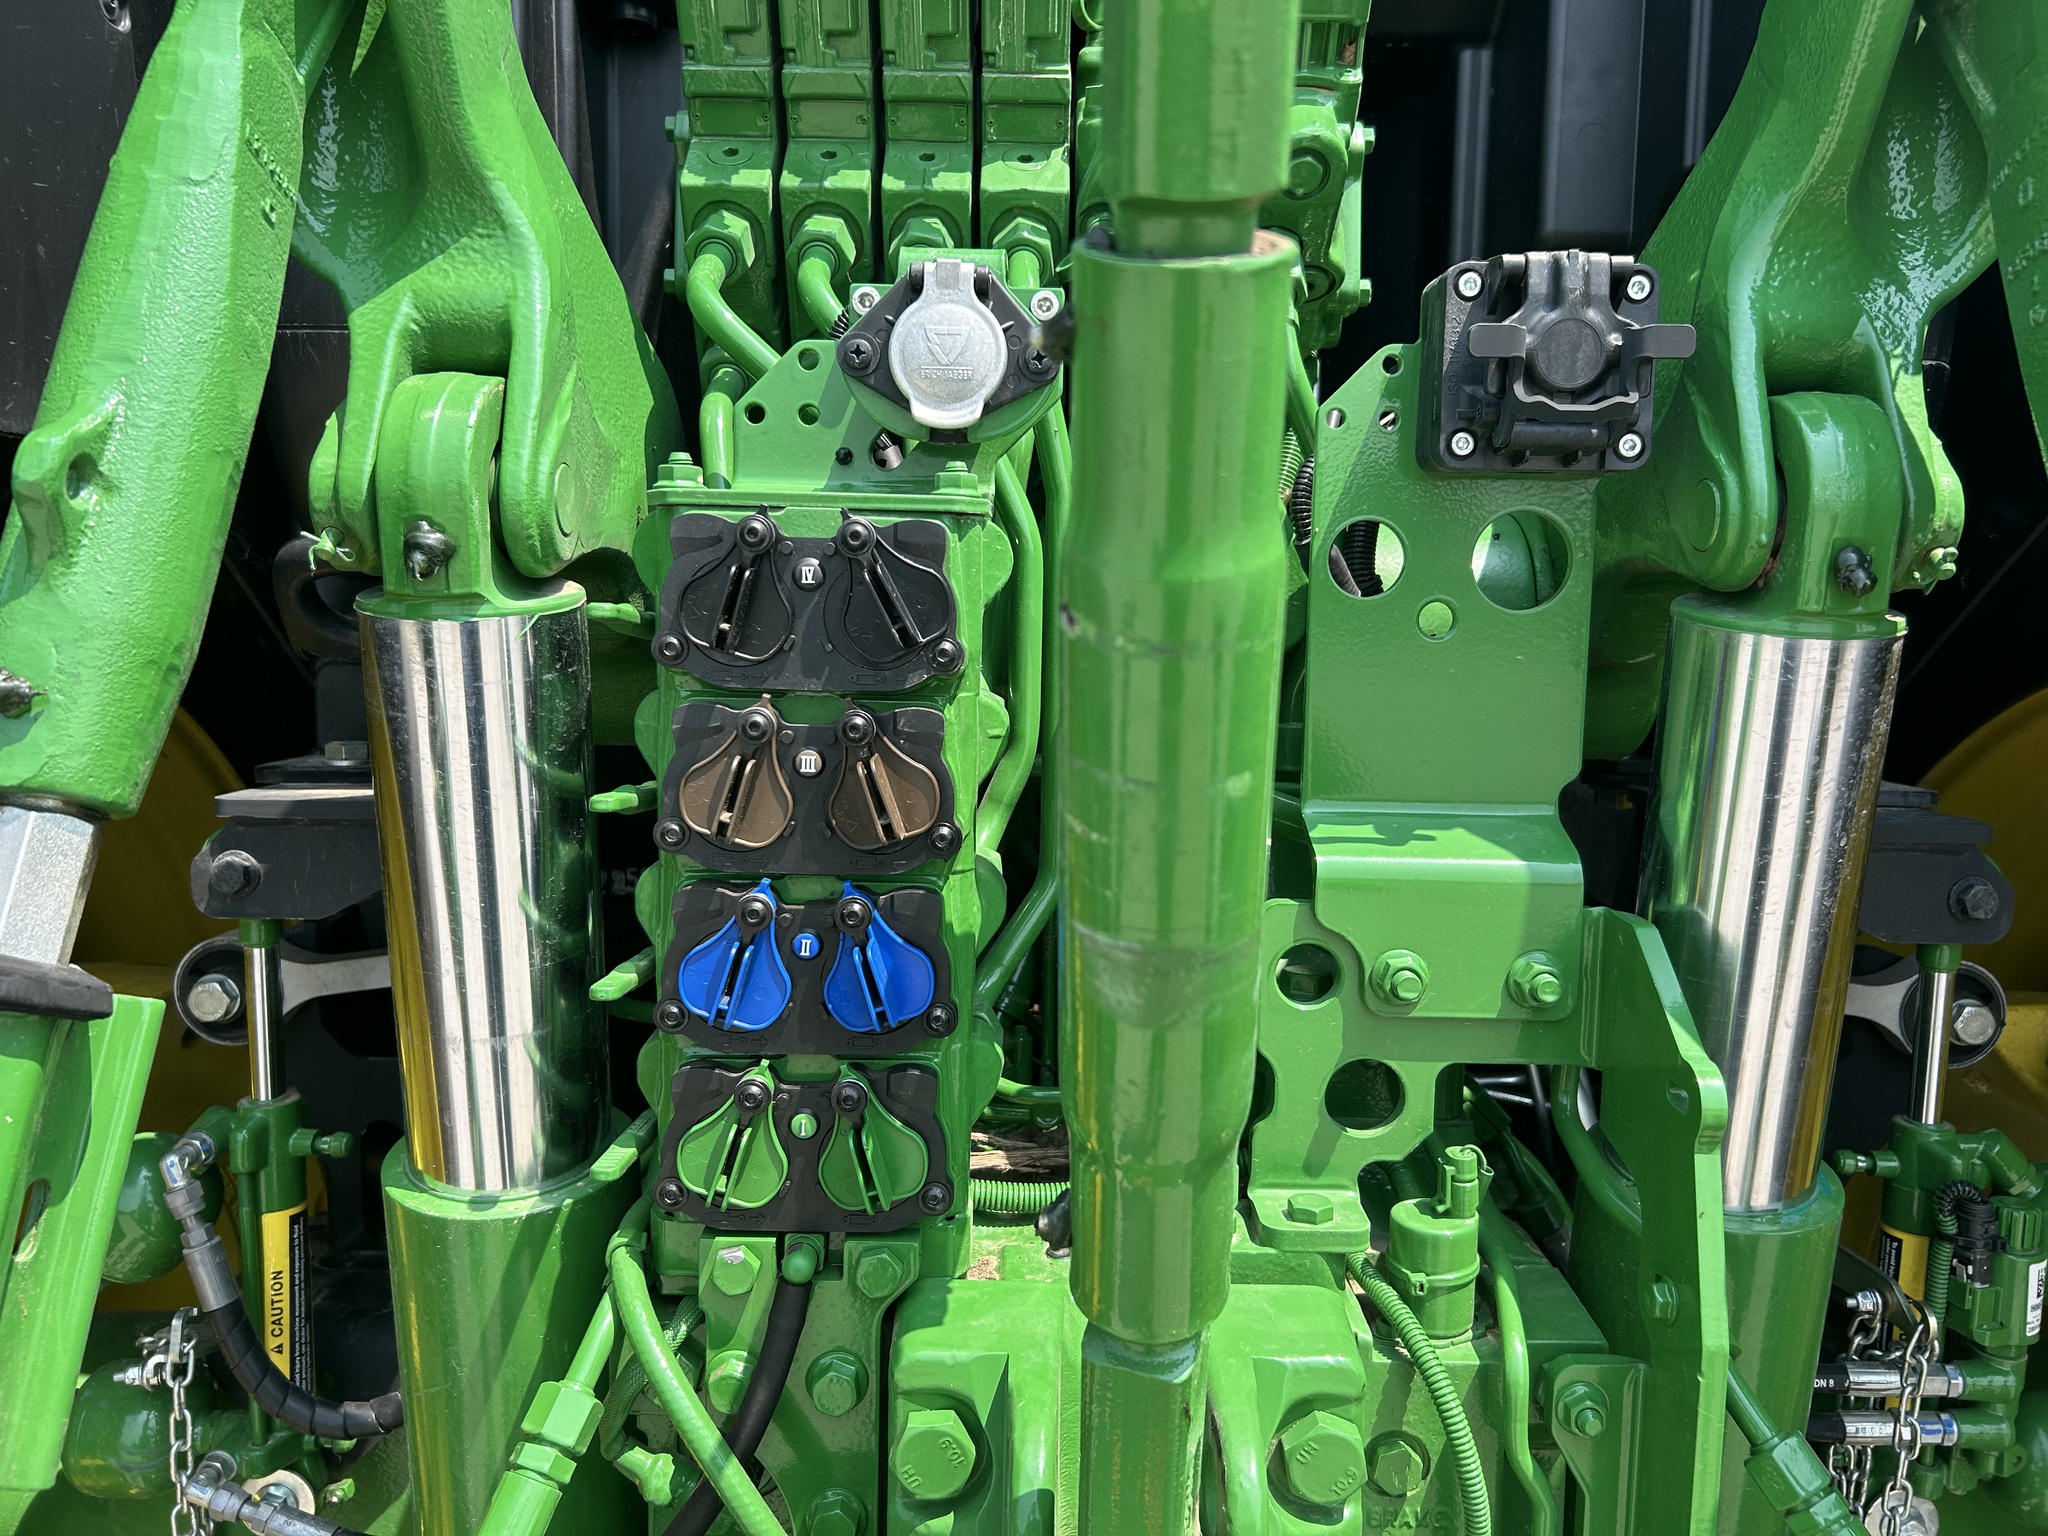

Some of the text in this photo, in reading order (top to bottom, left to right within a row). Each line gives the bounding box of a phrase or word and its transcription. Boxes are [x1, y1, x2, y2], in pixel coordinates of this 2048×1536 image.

[943, 369, 974, 380] JAEGER
[801, 566, 816, 584] IV
[800, 755, 817, 773] III
[800, 939, 812, 957] II
[800, 1119, 807, 1136] I
[270, 1269, 284, 1338] CAUTION
[1813, 1378, 1835, 1388] DN 8
[938, 1436, 967, 1468] 10.9
[1328, 1467, 1357, 1495] 10.9
[1366, 1506, 1451, 1529] BRAKE
